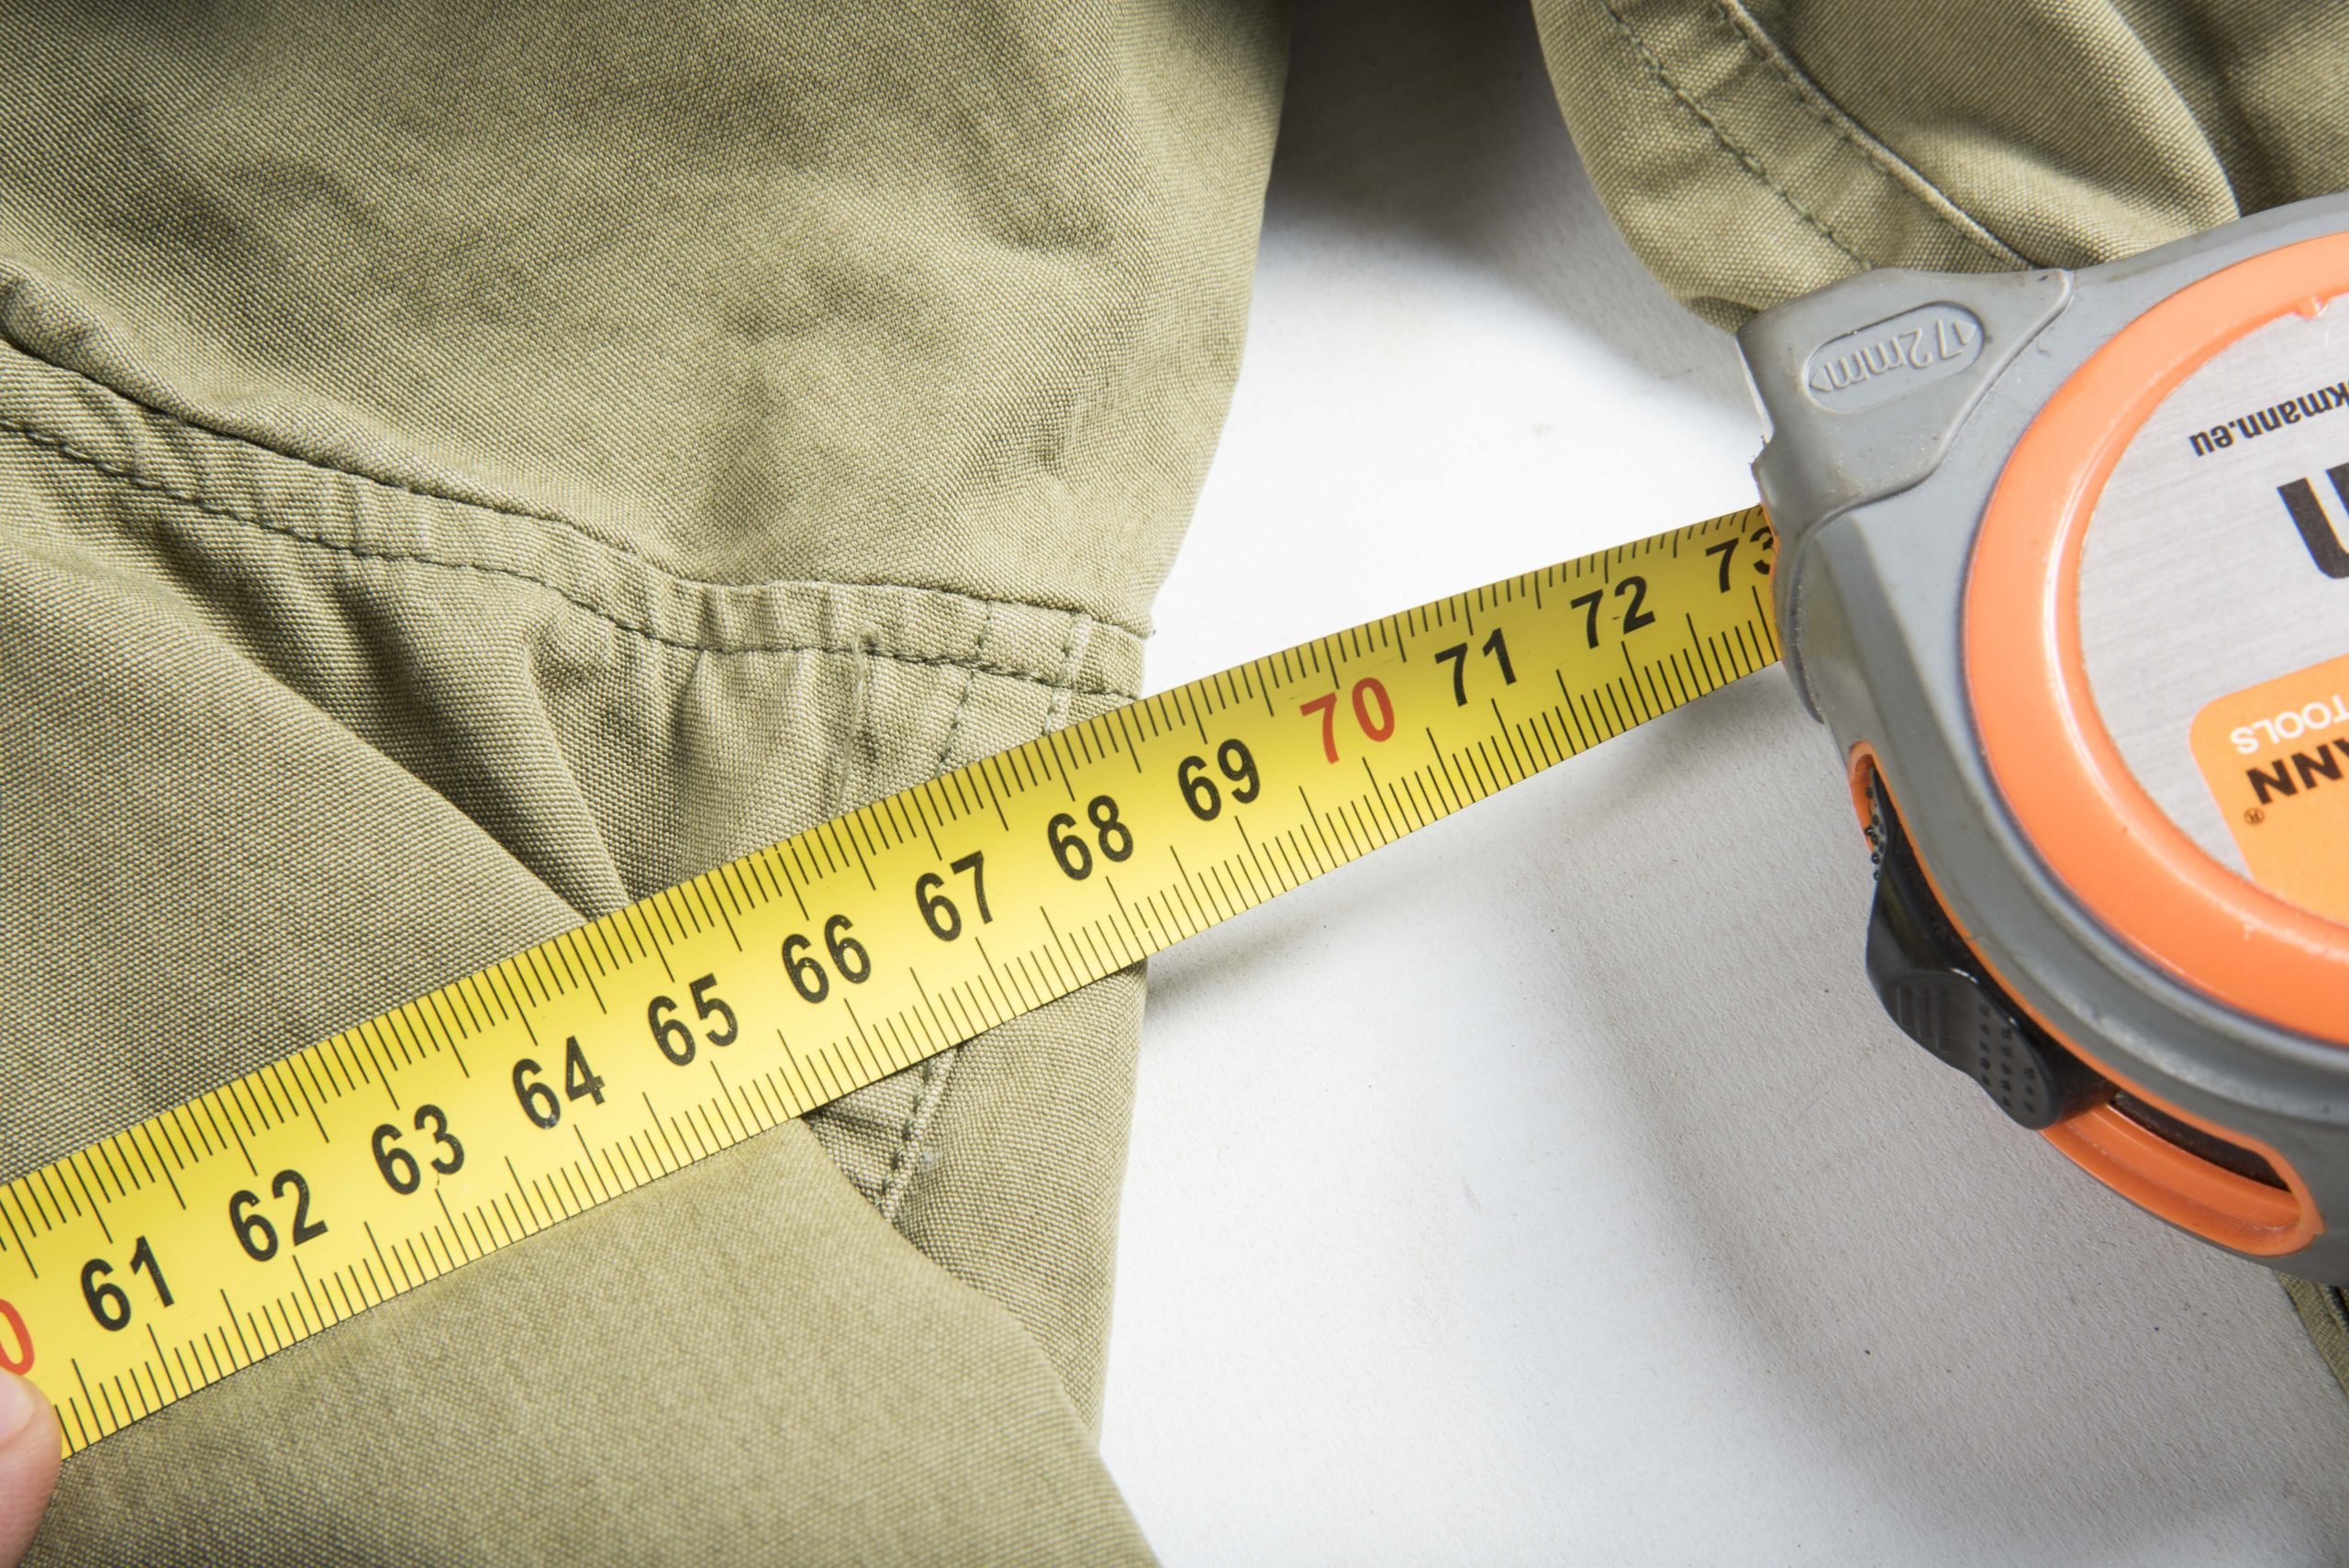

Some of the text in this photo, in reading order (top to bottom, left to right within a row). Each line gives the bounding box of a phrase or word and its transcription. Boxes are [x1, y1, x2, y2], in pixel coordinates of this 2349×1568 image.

[1825, 318, 1963, 390] 72mm
[2188, 381, 2349, 457] kmann.eu
[2230, 694, 2349, 754] TOOLS
[81, 1236, 174, 1331] 61
[228, 1169, 328, 1262] 62
[372, 1104, 465, 1195] 63
[512, 1036, 606, 1129] 64
[648, 973, 738, 1066] 65
[782, 914, 871, 1004] 66
[915, 851, 993, 941] 67
[1047, 795, 1133, 881] 68
[1177, 739, 1260, 821] 69
[1299, 677, 1396, 764] 70
[1434, 627, 1517, 707] 71
[1570, 575, 1656, 650] 72
